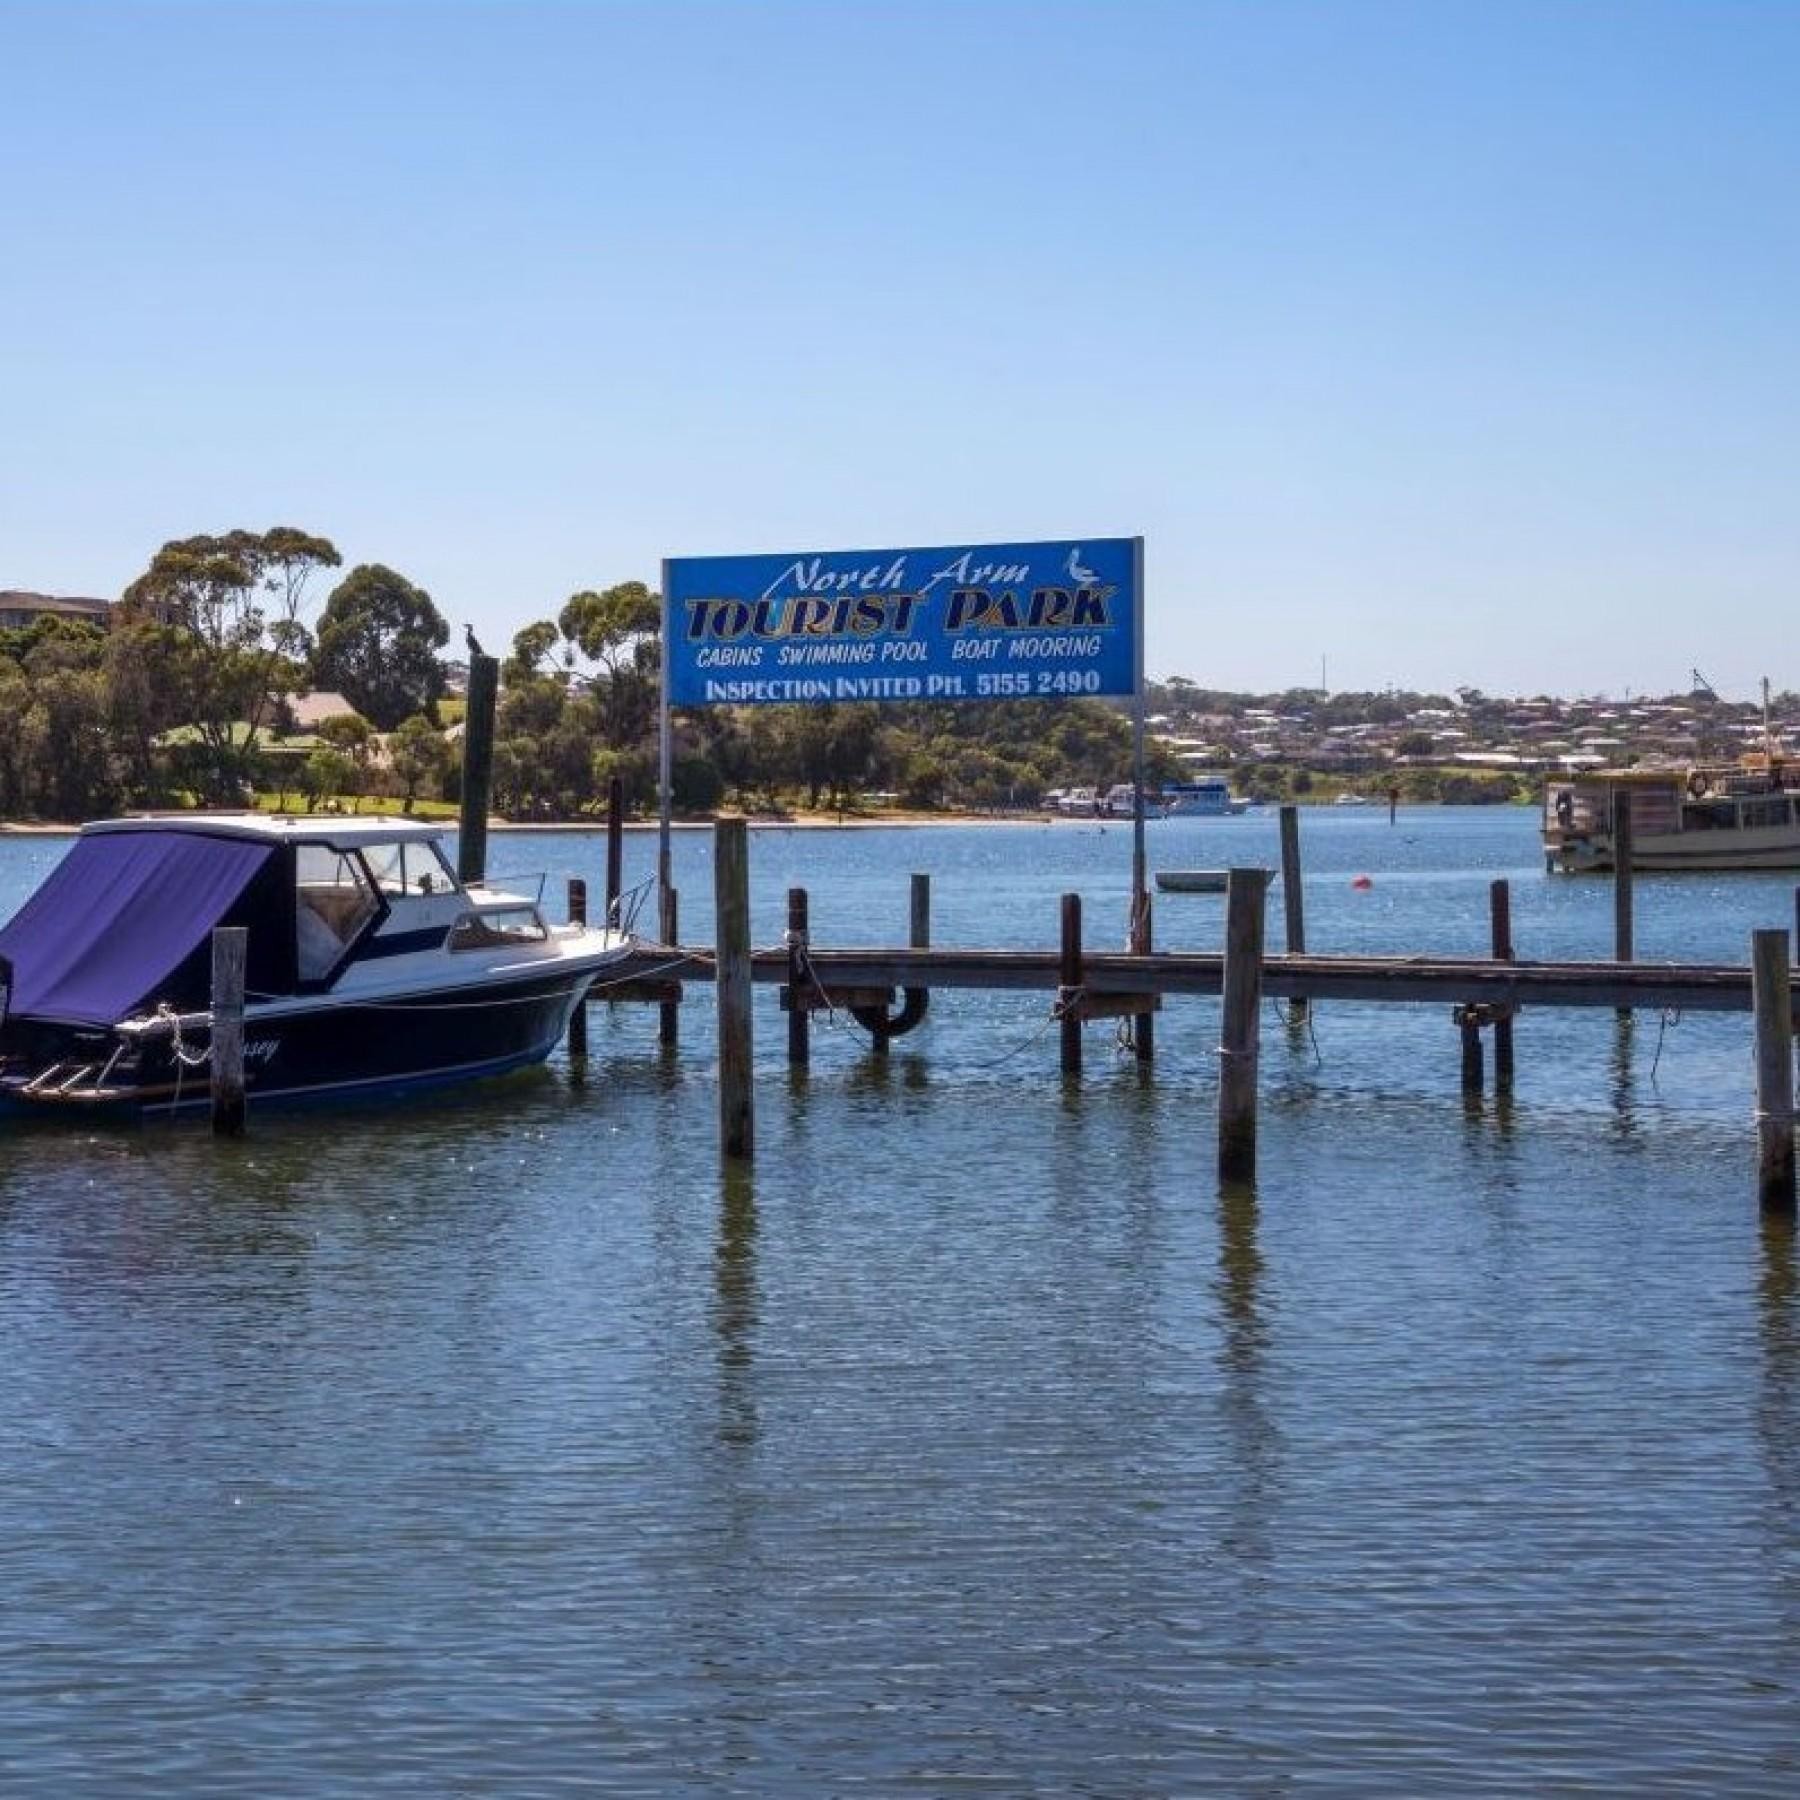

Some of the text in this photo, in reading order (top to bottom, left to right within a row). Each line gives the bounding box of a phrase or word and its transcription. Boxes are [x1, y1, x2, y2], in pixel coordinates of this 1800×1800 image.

[761, 552, 1030, 599] North Arm
[686, 584, 1121, 643] TOURIST PARK
[697, 635, 1100, 667] CABINS SWIMMING POOL BOAT MOORING
[706, 680, 831, 700] INSPECTION
[836, 676, 921, 697] INVITED
[976, 673, 1030, 694] 5155
[1037, 669, 1100, 693] 2490
